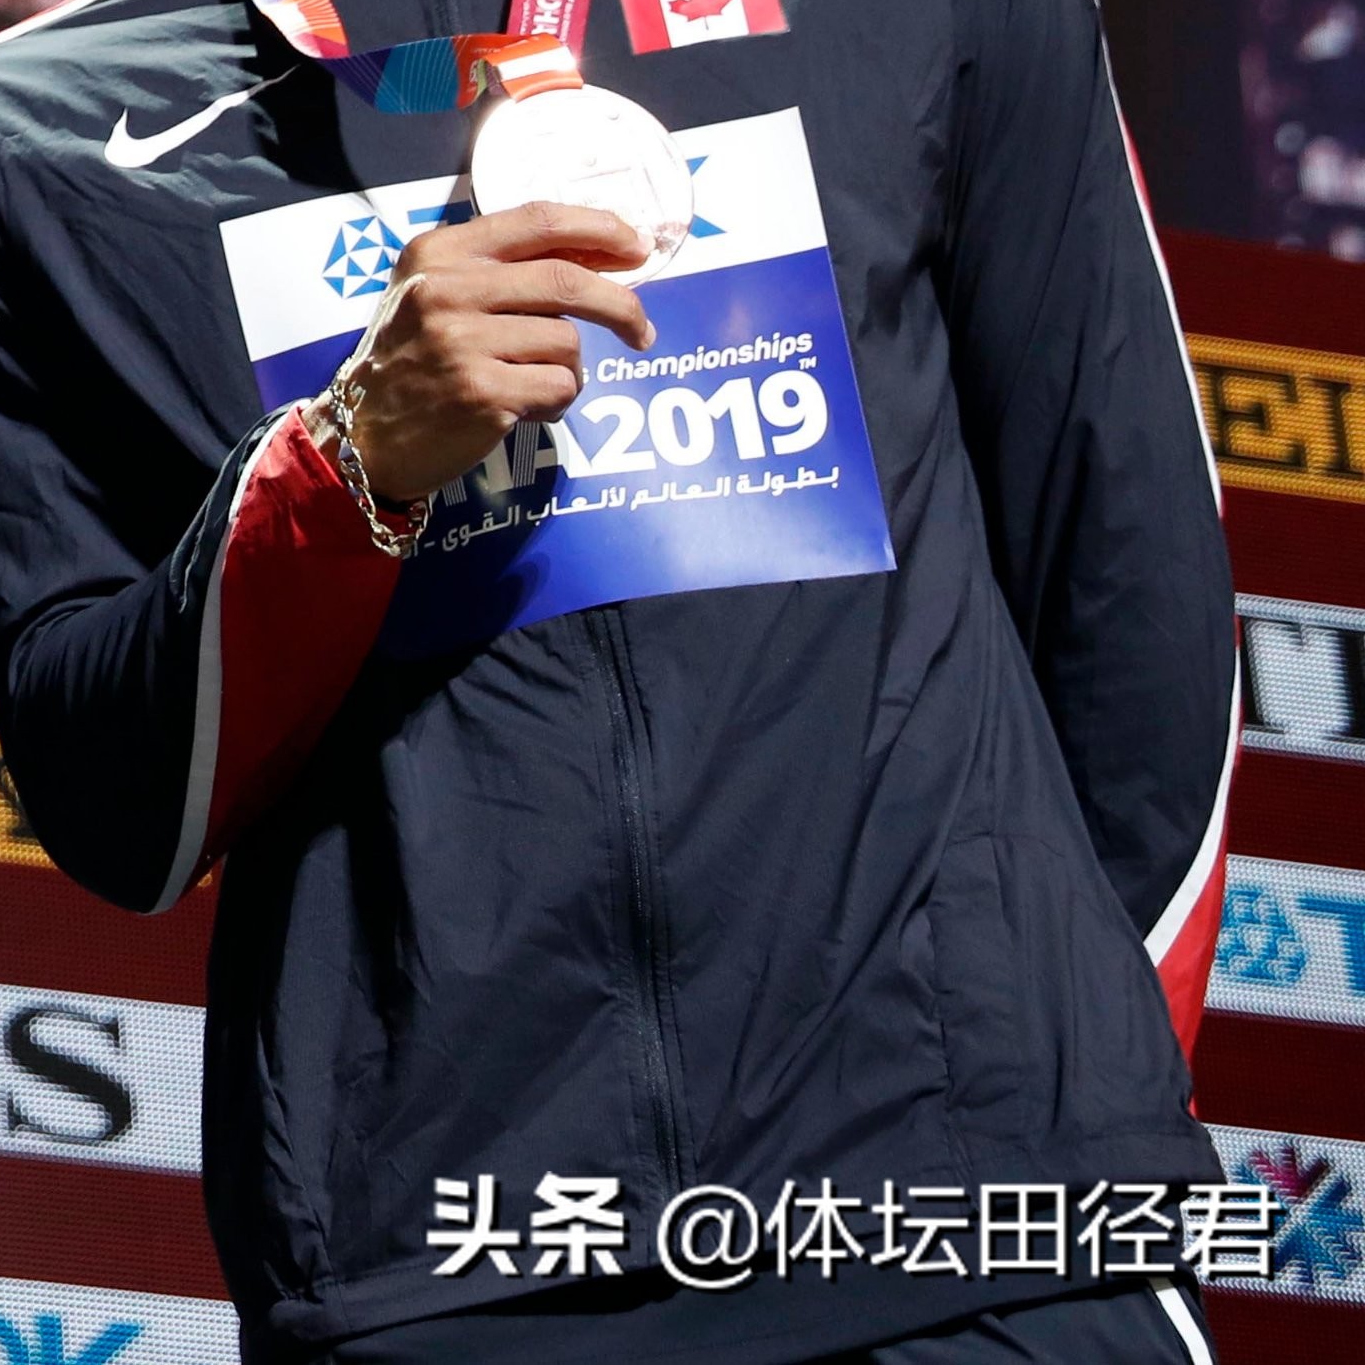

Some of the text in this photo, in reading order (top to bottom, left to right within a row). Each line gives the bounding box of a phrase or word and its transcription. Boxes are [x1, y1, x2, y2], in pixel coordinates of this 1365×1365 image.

[595, 331, 814, 385] Championships
[629, 475, 732, 511] العالم
[735, 465, 840, 497] بطولة
